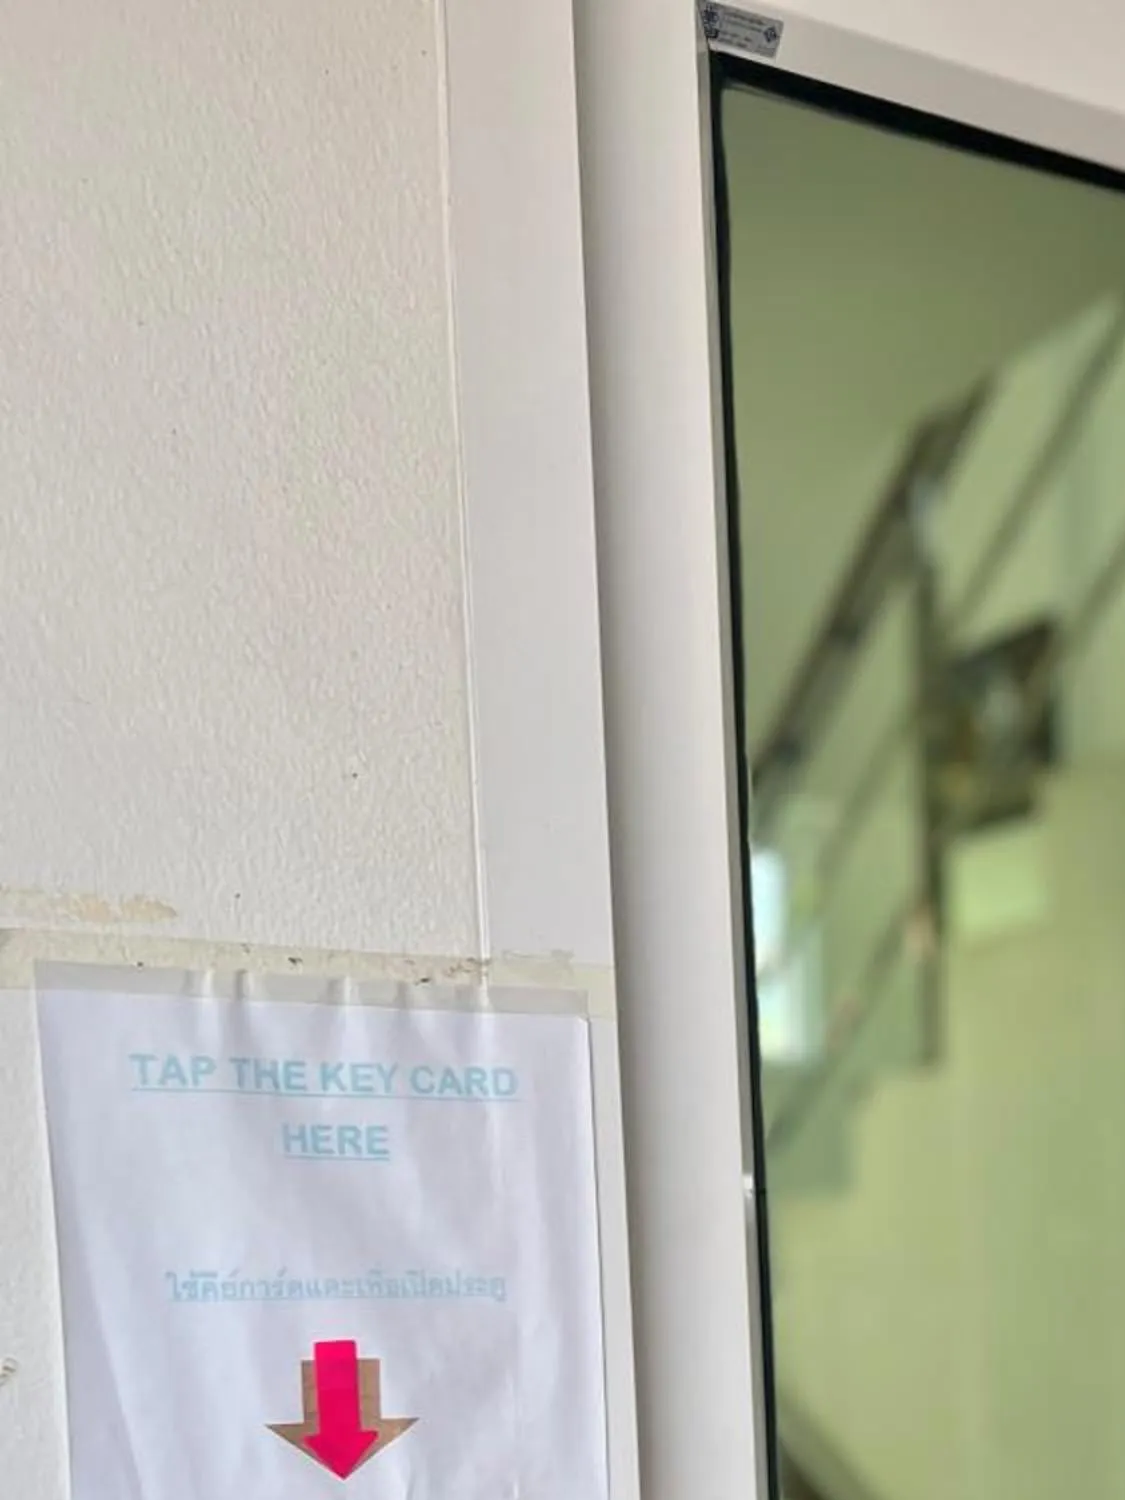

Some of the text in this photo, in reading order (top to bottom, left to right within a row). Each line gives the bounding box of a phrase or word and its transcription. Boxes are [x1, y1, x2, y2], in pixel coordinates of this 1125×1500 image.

[129, 1053, 518, 1097] TAP THE KEY CARD
[282, 1122, 390, 1157] HERE
